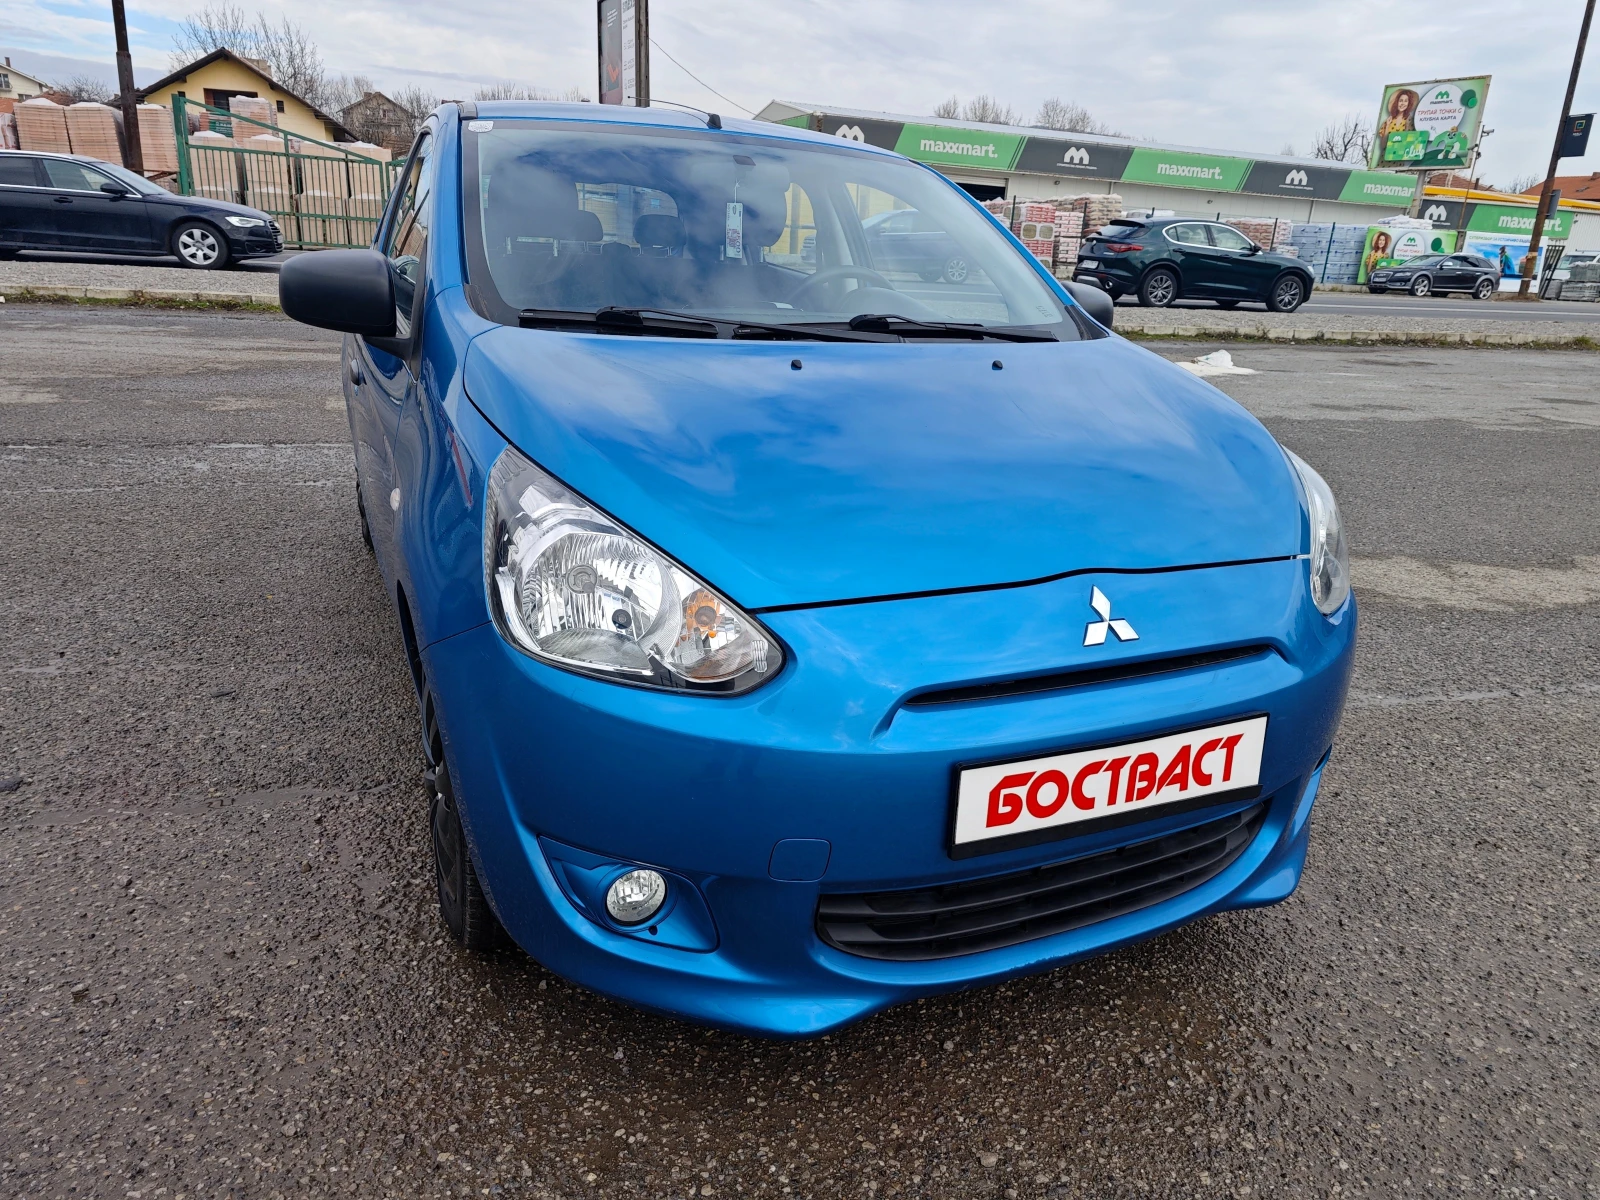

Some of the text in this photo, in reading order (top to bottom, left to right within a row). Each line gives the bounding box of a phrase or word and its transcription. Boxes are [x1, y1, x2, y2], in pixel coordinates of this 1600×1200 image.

[920, 139, 998, 158] maxxmart.
[1157, 163, 1223, 180] maxxmart.
[1363, 183, 1415, 198] maxxmar
[985, 732, 1245, 829] БОСТВАСТ
